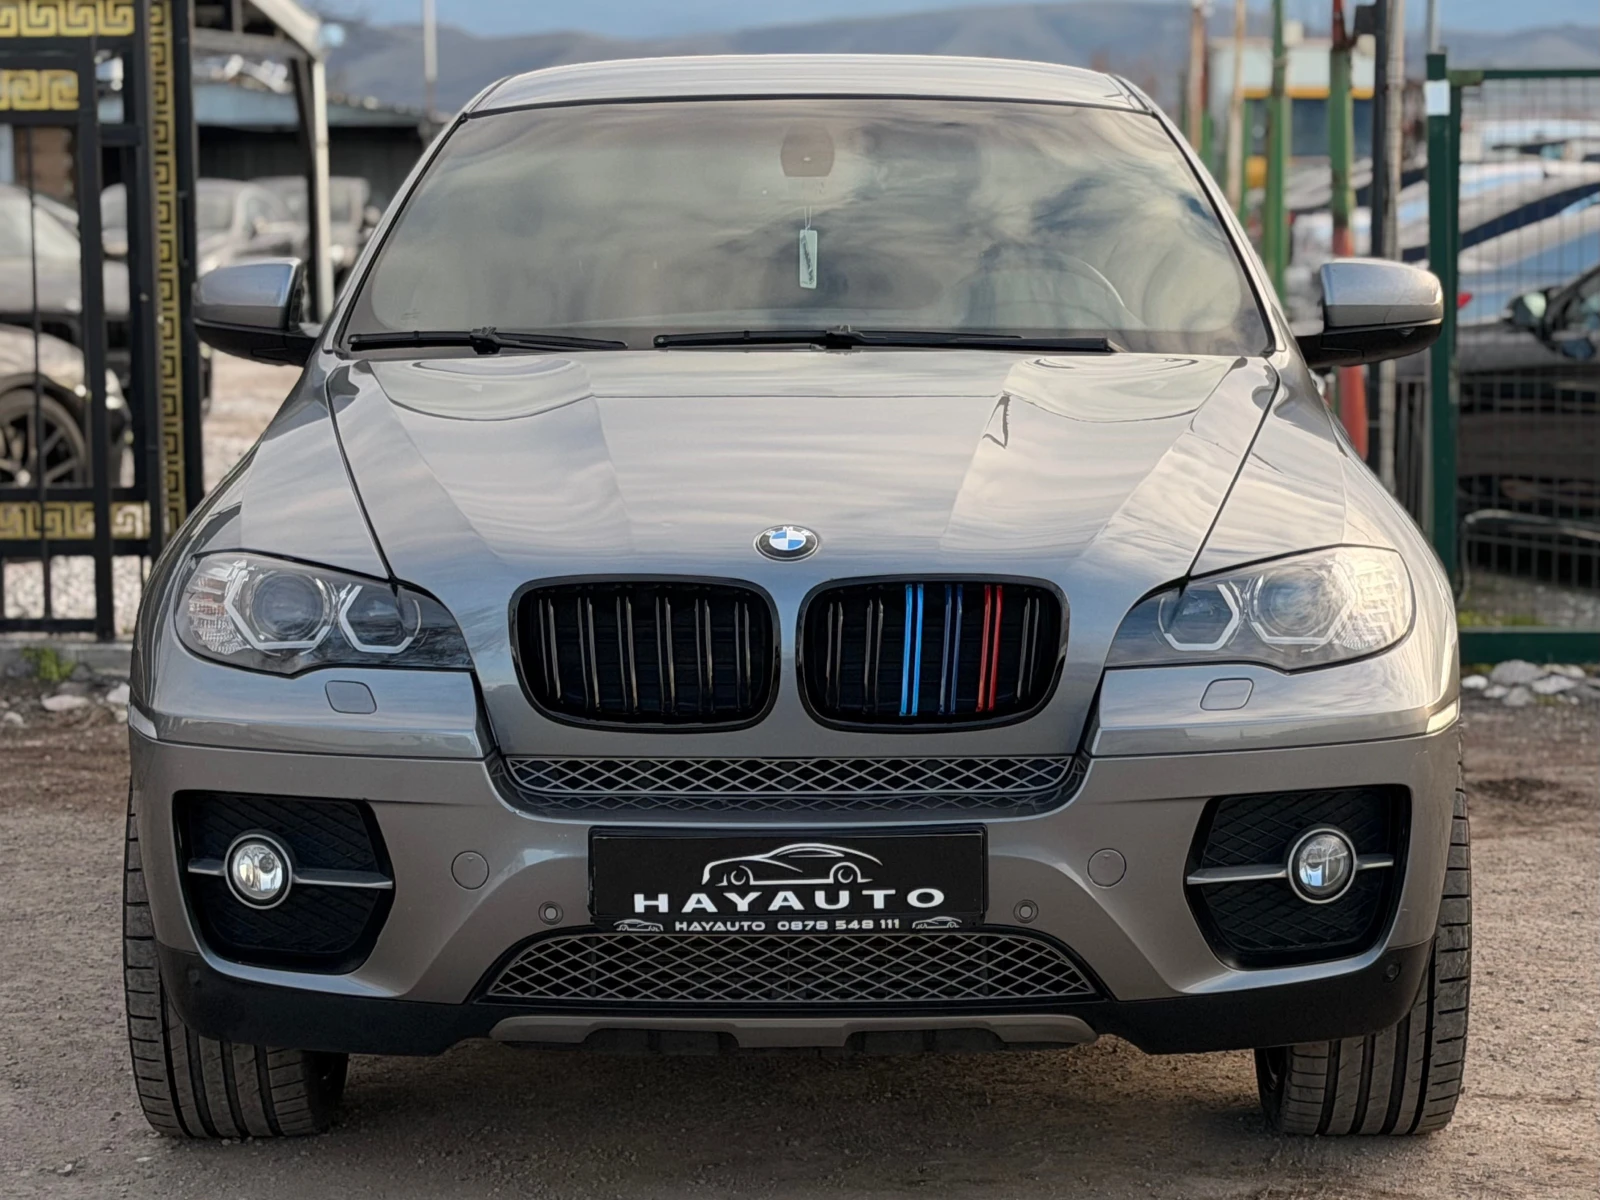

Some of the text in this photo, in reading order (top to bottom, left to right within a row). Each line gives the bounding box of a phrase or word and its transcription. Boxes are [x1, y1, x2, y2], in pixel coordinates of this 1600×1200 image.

[633, 888, 945, 913] HAYAUTO
[674, 918, 900, 932] HAYAUTO 0878 548 111
